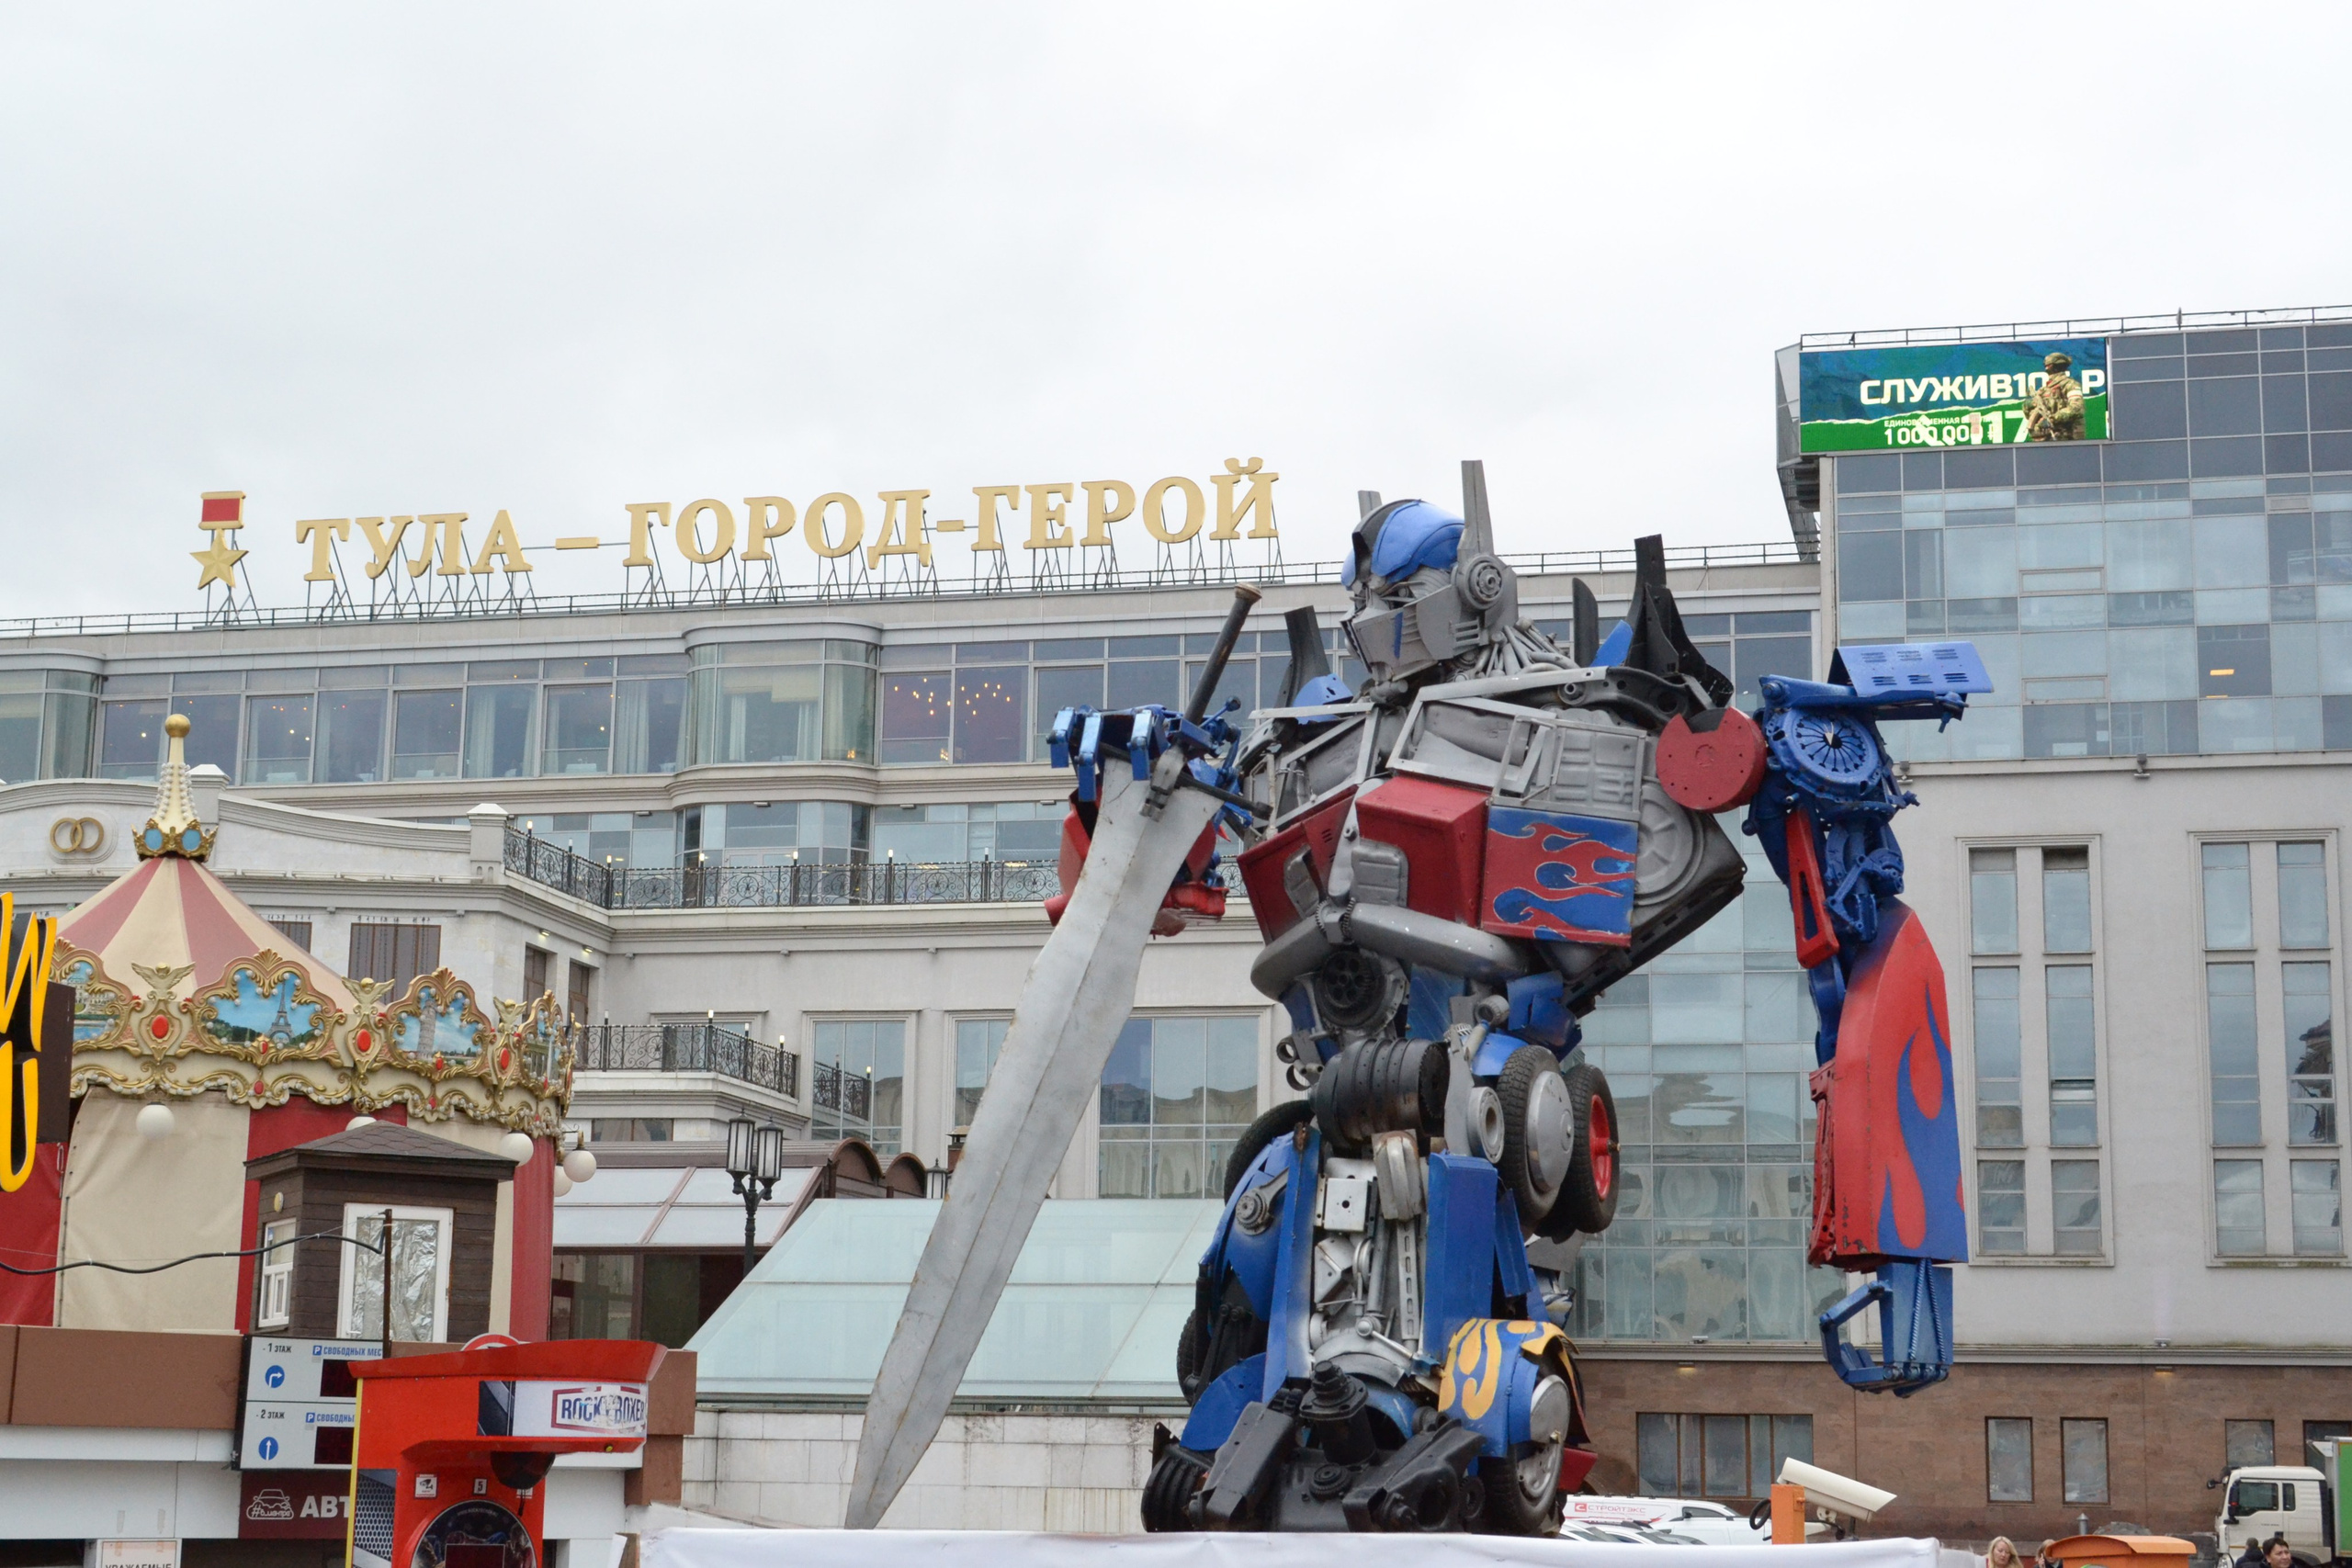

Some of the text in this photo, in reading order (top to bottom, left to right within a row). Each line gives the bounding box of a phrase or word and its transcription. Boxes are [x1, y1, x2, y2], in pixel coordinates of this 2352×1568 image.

[296, 510, 533, 581] ТУЛА
[623, 457, 1280, 570] ГОРОД-ГЕРОЙ
[323, 1347, 366, 1357] СВОБОДНЫХ
[368, 1348, 382, 1357] МЕС
[317, 1414, 355, 1423] СВОБОДНЫ
[477, 1481, 483, 1493] 5
[300, 1495, 350, 1518] АВТ
[1588, 1505, 1646, 1514] СТРОЙТЭКС
